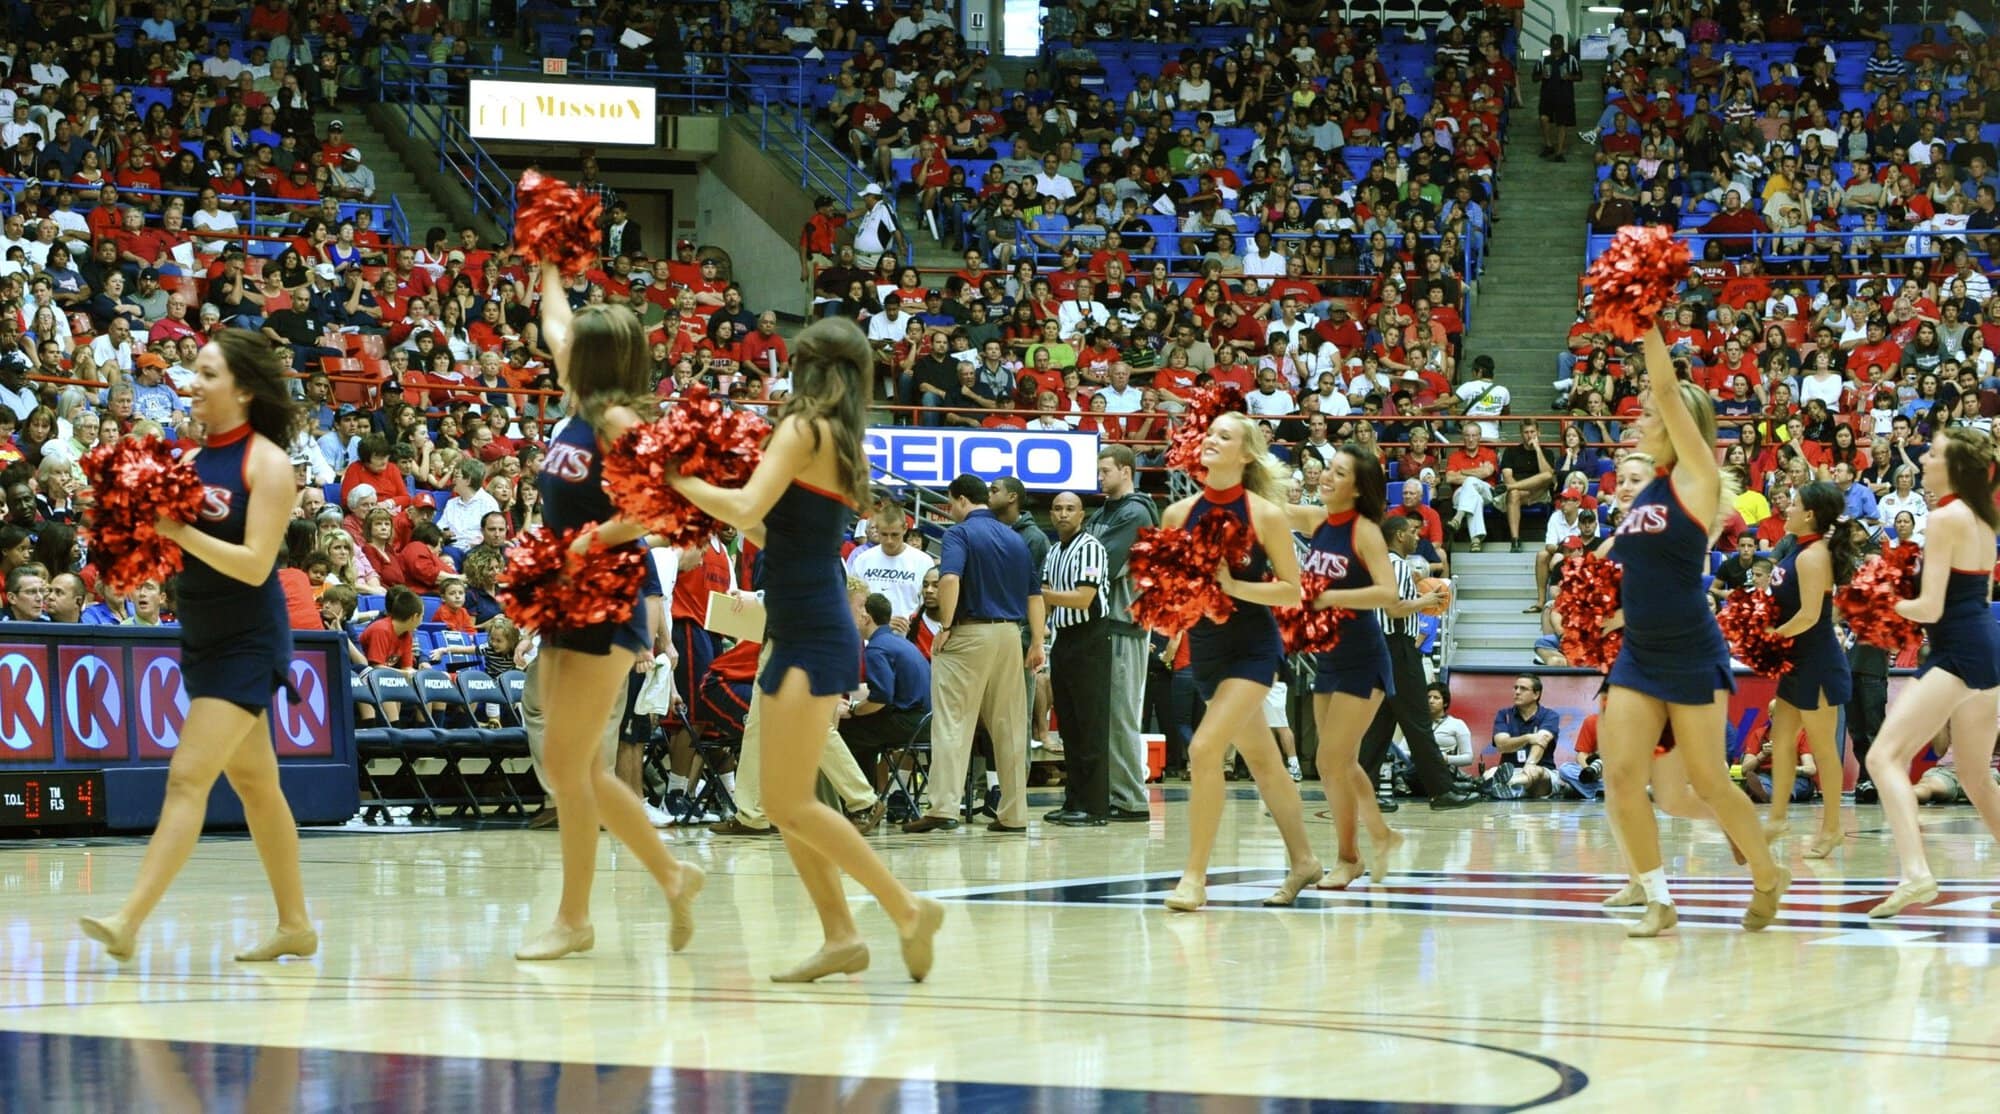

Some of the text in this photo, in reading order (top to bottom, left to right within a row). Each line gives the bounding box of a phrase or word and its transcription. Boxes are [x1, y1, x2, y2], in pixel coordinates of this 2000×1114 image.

[547, 60, 564, 72] EXIT
[864, 568, 916, 581] ARIZONA
[379, 677, 408, 688] ARIZONA
[424, 679, 453, 689] ARIZONA
[467, 679, 497, 690] ARIZONA
[70, 657, 120, 748] K
[78, 779, 93, 816] 4
[50, 799, 65, 810] FLS
